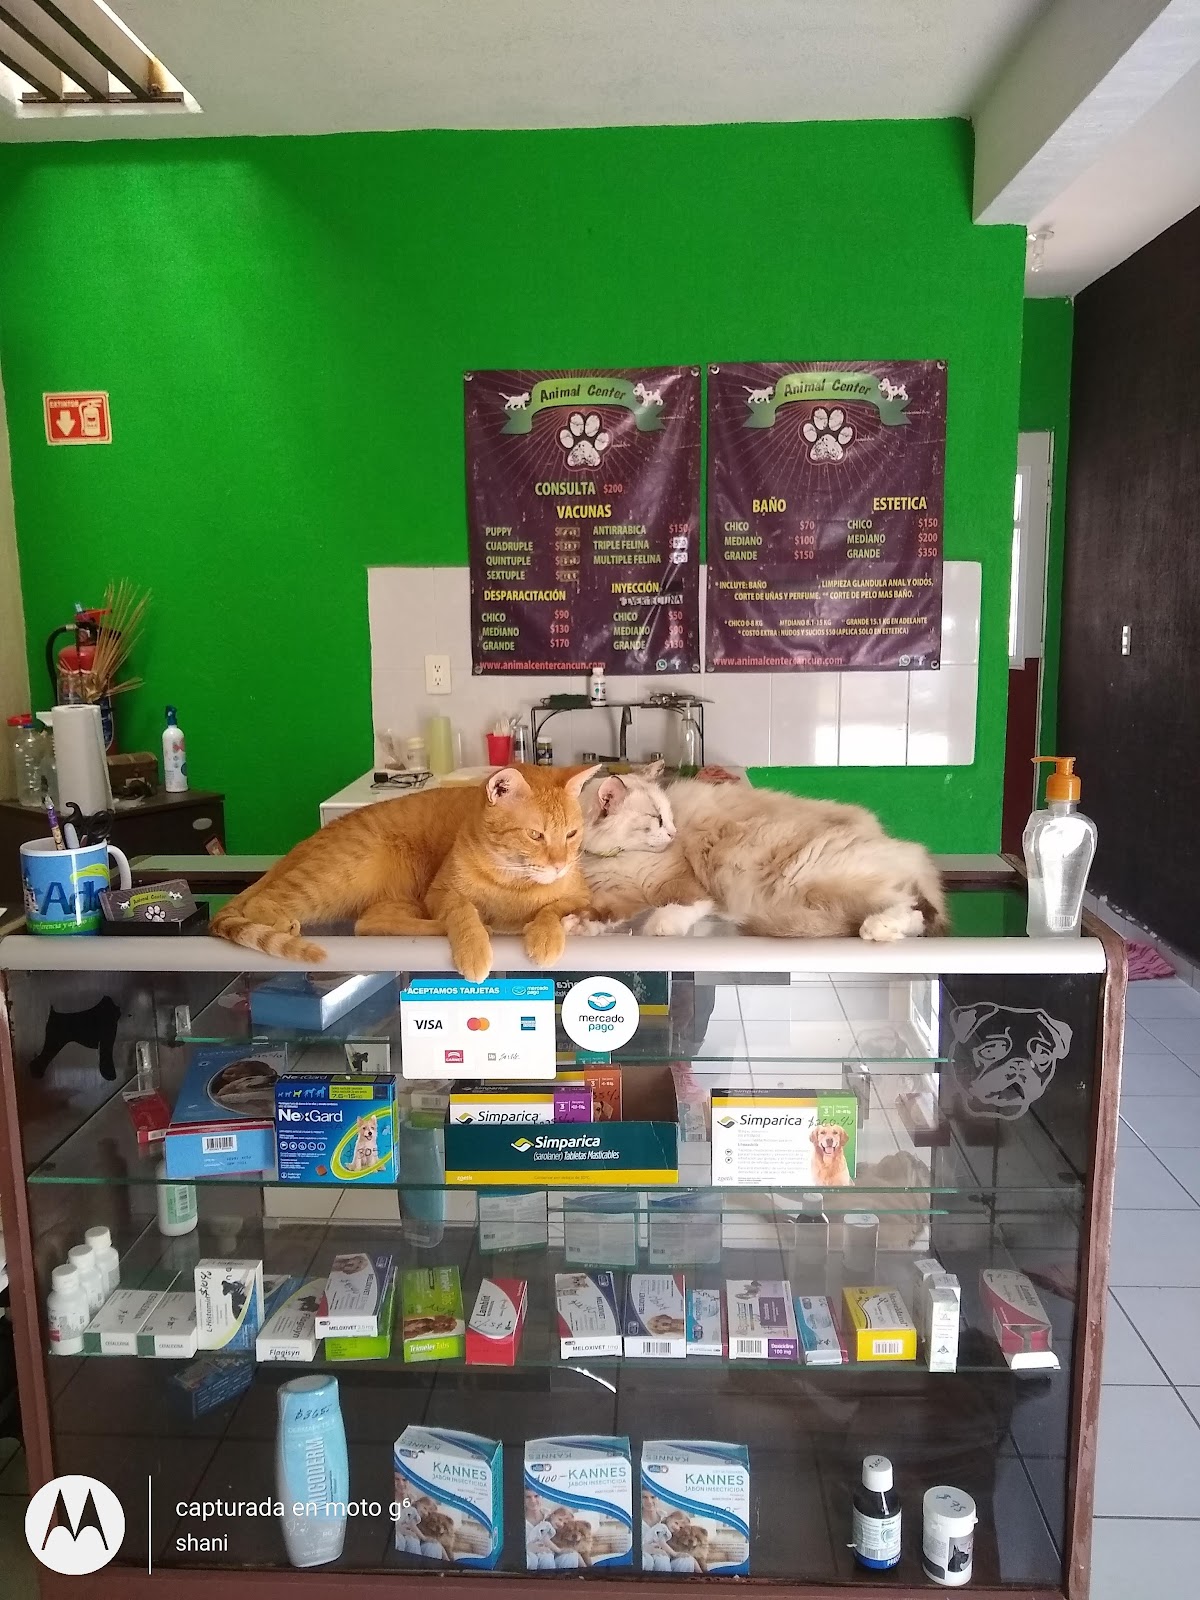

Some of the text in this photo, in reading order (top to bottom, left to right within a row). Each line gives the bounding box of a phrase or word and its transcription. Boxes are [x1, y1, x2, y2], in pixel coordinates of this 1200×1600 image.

[540, 384, 626, 403] Animal Center
[784, 379, 872, 397] Animal Center
[535, 482, 623, 495] CONSULTA $200
[752, 496, 787, 513] BAÑO
[873, 496, 928, 511] ESTETICA
[556, 504, 612, 519] VACUNAS
[724, 520, 815, 531] CHICO $70
[847, 517, 938, 529] CHICO $150
[485, 527, 512, 537] PUPPY
[593, 525, 646, 535] ANTIRRABICA
[724, 535, 815, 546] MEDIANO $100
[847, 532, 938, 544] MEDIANO $200
[485, 541, 533, 552] CUADRUPLE
[593, 540, 620, 550] TRIPLE
[621, 539, 650, 549] FELINA
[724, 550, 814, 560] GRANDE $150
[847, 547, 938, 559] GRANDE $350
[486, 556, 531, 566] QUINTUPLE
[593, 554, 661, 565] MULTIPLE FELINA
[486, 571, 525, 580] SEXTUPLE
[611, 581, 660, 593] INYECCIÓN
[720, 579, 767, 589] INCLUYE: BAÑO
[822, 580, 851, 588] LIMPIEZA
[852, 579, 887, 588] GLANDULA
[888, 579, 906, 587] ANAL
[906, 579, 911, 587] Y
[484, 589, 566, 602] DESPARACITACIÓN
[734, 592, 754, 600] CORTE
[755, 592, 764, 600] DE
[765, 591, 783, 600] UÑAS
[789, 591, 820, 600] PERFUME.
[830, 591, 850, 600] CORTE
[851, 591, 859, 599] DE
[861, 591, 877, 599] PELO
[878, 590, 893, 599] MAS
[481, 610, 570, 622] CHICO $90
[613, 612, 638, 622] CHICO
[846, 618, 869, 626] GRANDE
[870, 618, 881, 626] 15.1
[899, 617, 928, 625] ADELANTE
[780, 619, 805, 627] MEDIANO
[482, 624, 570, 637] MEDIANO $130
[613, 625, 683, 636] MEDIANO $90
[742, 629, 760, 637] COSTO
[482, 639, 570, 651] GRANDE $170
[613, 640, 646, 650] GRANDE
[480, 660, 605, 671] www.animalcentercancun.com
[713, 656, 843, 667] www.animalcentercancun.com
[460, 987, 500, 995] TARJETAS
[413, 1020, 443, 1029] VISA
[579, 1015, 625, 1023] mercado
[588, 1024, 615, 1033] pago
[278, 1109, 343, 1122] NexGard
[477, 1111, 540, 1123] Simparica
[739, 1114, 802, 1128] Simparica
[534, 1134, 601, 1151] Simparica
[533, 1150, 620, 1161] (sarolaner) Tabletas Masticables
[433, 1462, 487, 1480] KANNES
[568, 1467, 626, 1480] KANNES
[451, 1476, 487, 1487] INSECTICIDA
[588, 1479, 626, 1487] INSECTICIDA
[685, 1473, 744, 1486] KANNES
